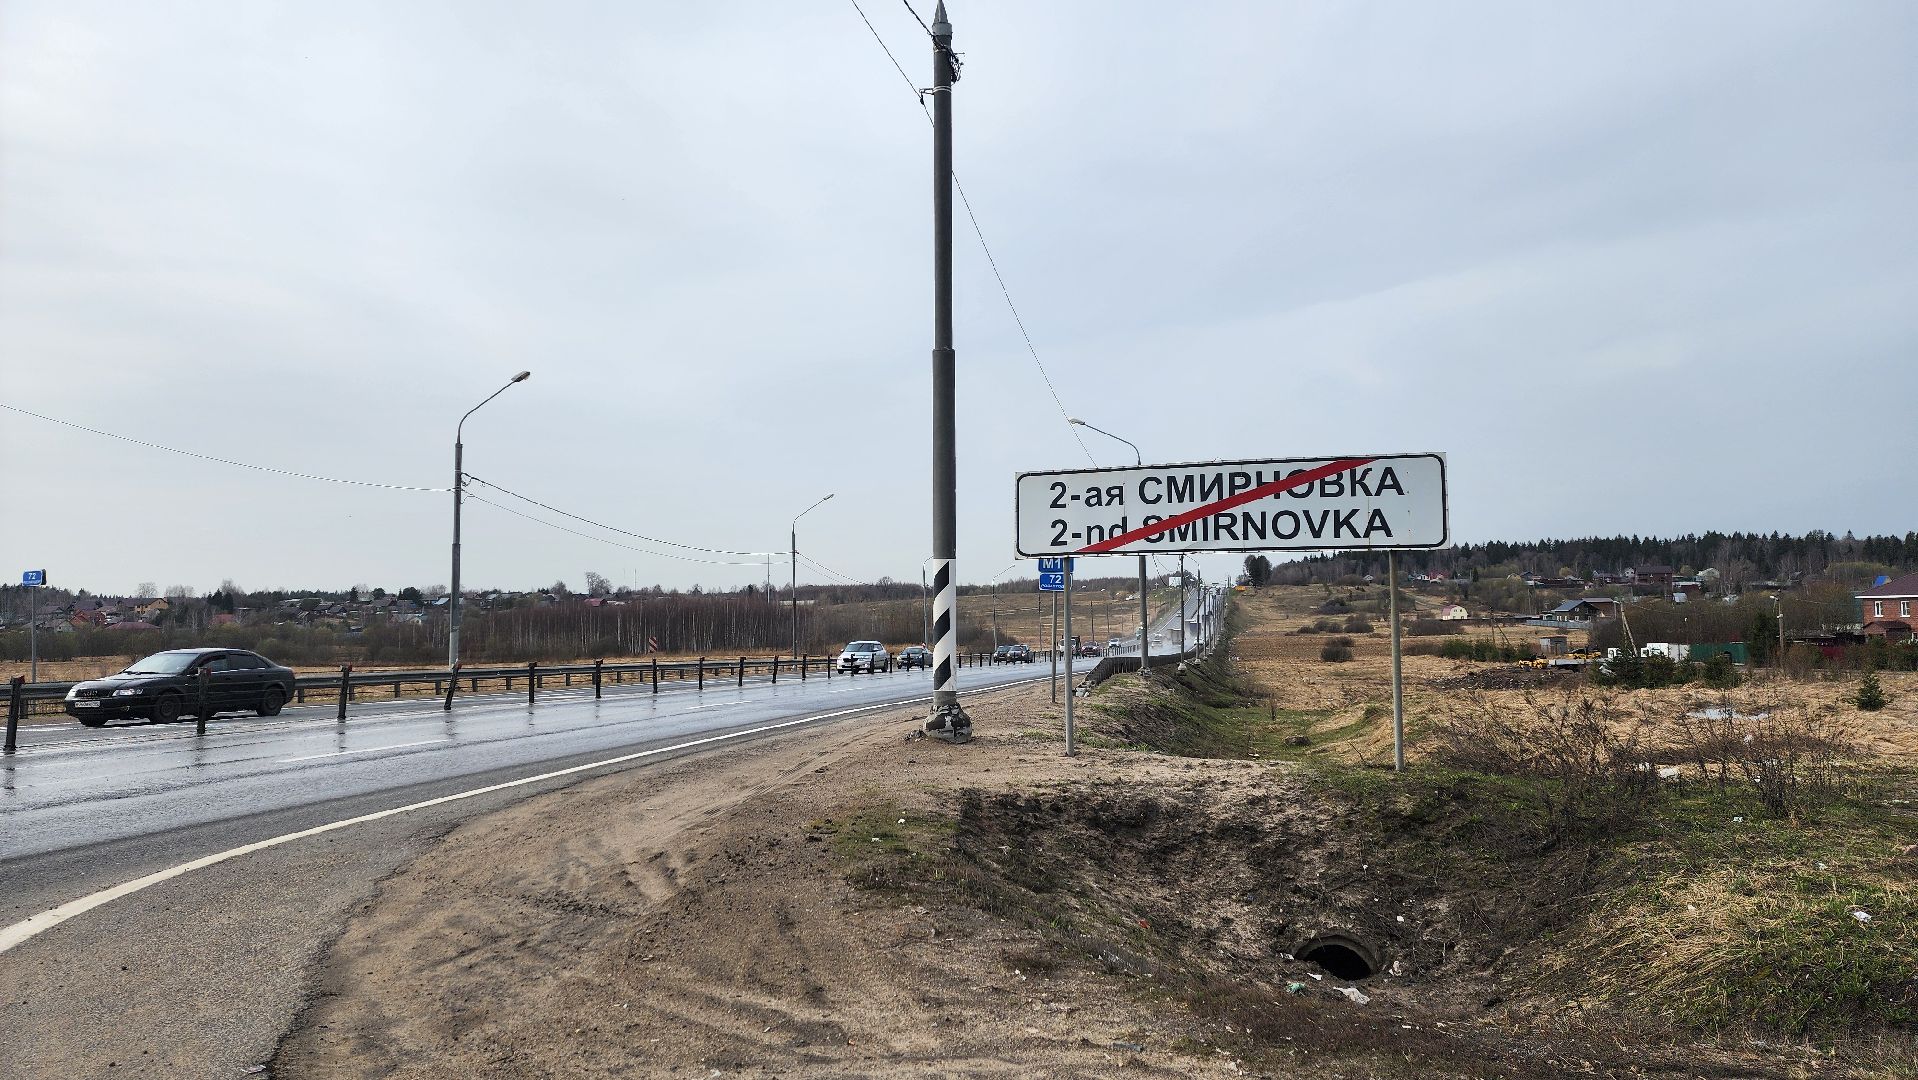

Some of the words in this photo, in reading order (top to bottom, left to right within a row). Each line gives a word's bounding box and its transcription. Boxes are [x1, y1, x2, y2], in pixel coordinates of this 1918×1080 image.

[1049, 481, 1125, 509] 2-ая
[1138, 466, 1405, 506] СМИРНОВКА
[1049, 516, 1128, 548] 2-nd
[1141, 508, 1394, 545] SMIRNOVKA
[28, 572, 37, 580] 72
[1049, 574, 1062, 584] 72
